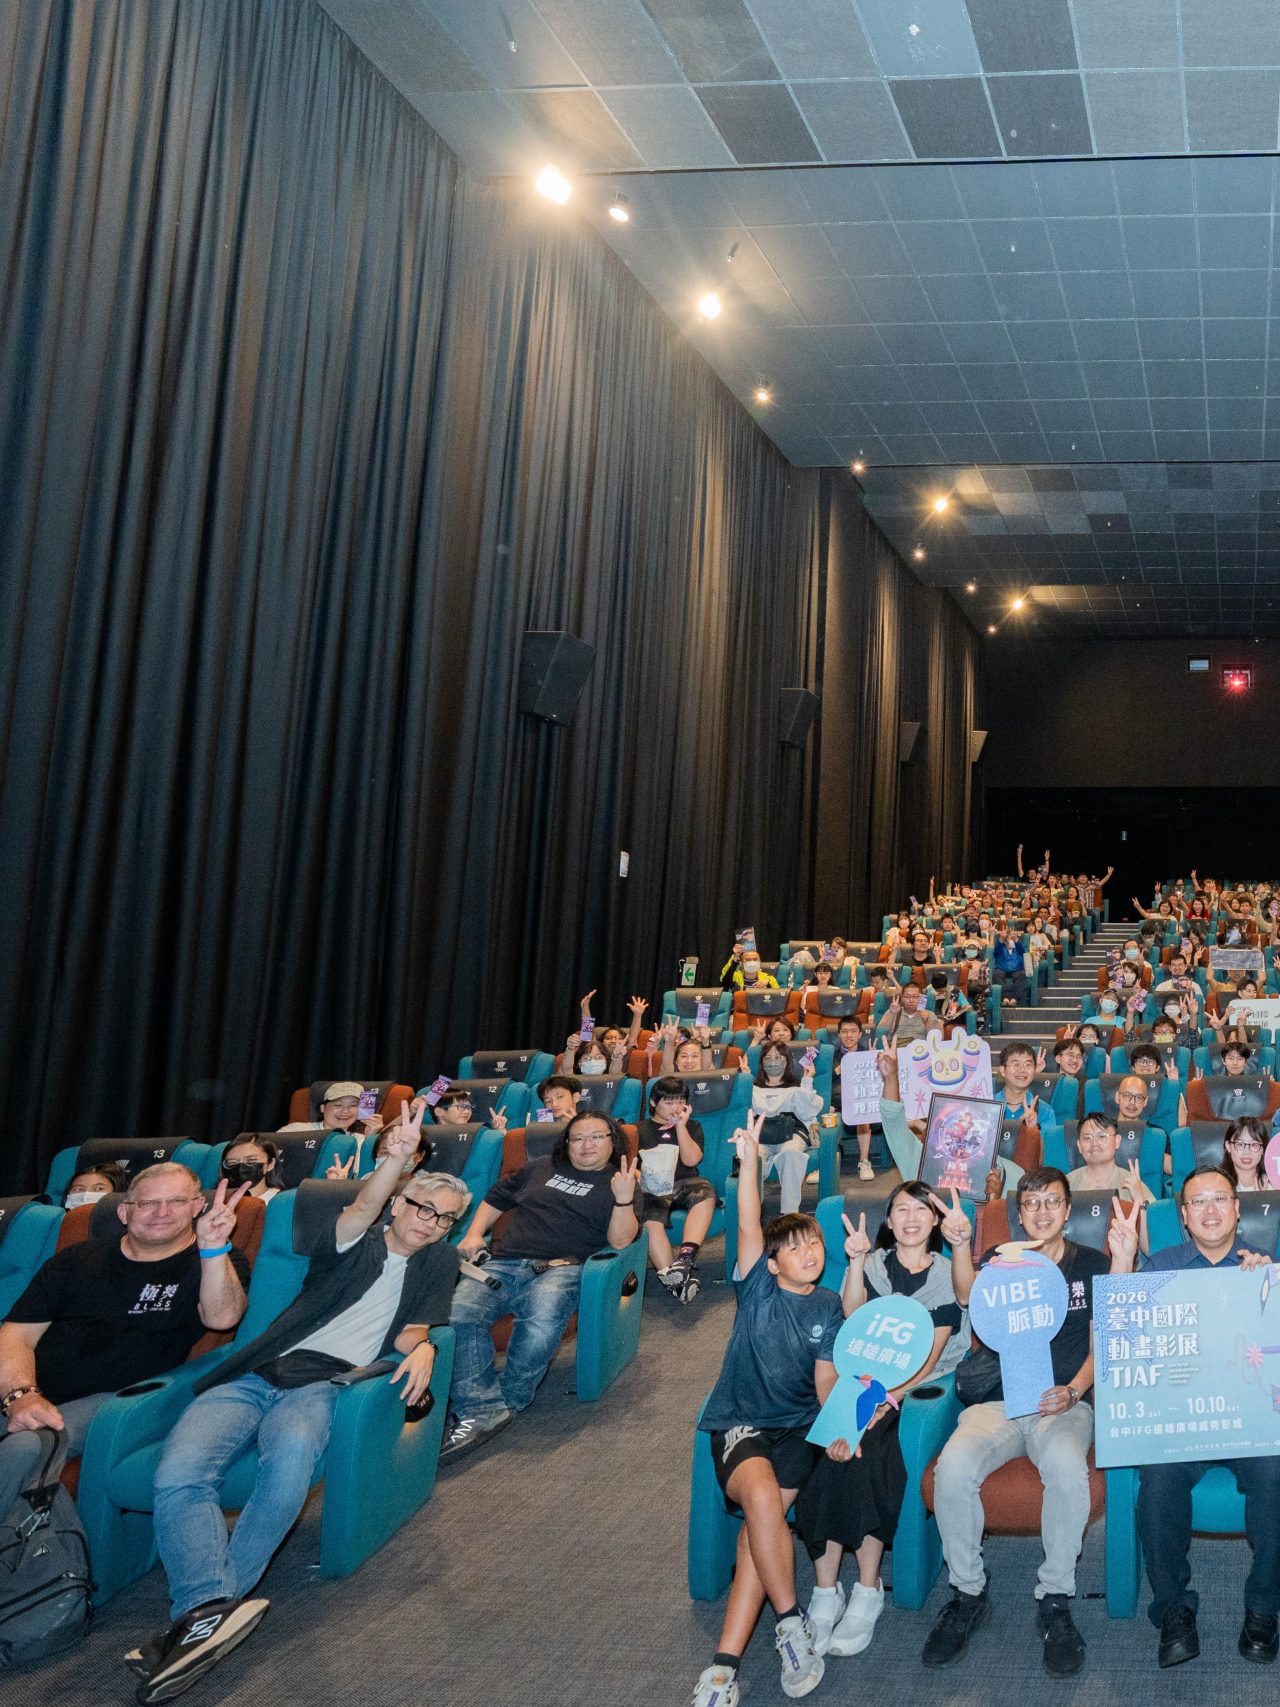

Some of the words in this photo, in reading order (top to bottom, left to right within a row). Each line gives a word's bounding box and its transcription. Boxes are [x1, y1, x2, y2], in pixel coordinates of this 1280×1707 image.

[488, 1085, 497, 1093] 12
[304, 1140, 315, 1148] 12
[458, 1133, 467, 1141] 11
[1004, 1132, 1010, 1140] 9
[1128, 1131, 1134, 1140] 8
[153, 1150, 164, 1158] 13
[1091, 1206, 1100, 1216] 8
[1261, 1204, 1270, 1216] 7
[140, 1283, 179, 1301] 極樂
[982, 1278, 1041, 1308] VIBE
[1067, 1281, 1085, 1298] 樂
[1107, 1291, 1147, 1304] 2026
[1008, 1303, 1055, 1334] 脈動
[1107, 1303, 1198, 1331] 臺中國際
[866, 1313, 916, 1345] iFG
[845, 1338, 912, 1370] 遠雄廣場
[1108, 1332, 1200, 1360] 動畫影展
[1109, 1364, 1164, 1388] TIAF
[1187, 1395, 1225, 1414] 10.10
